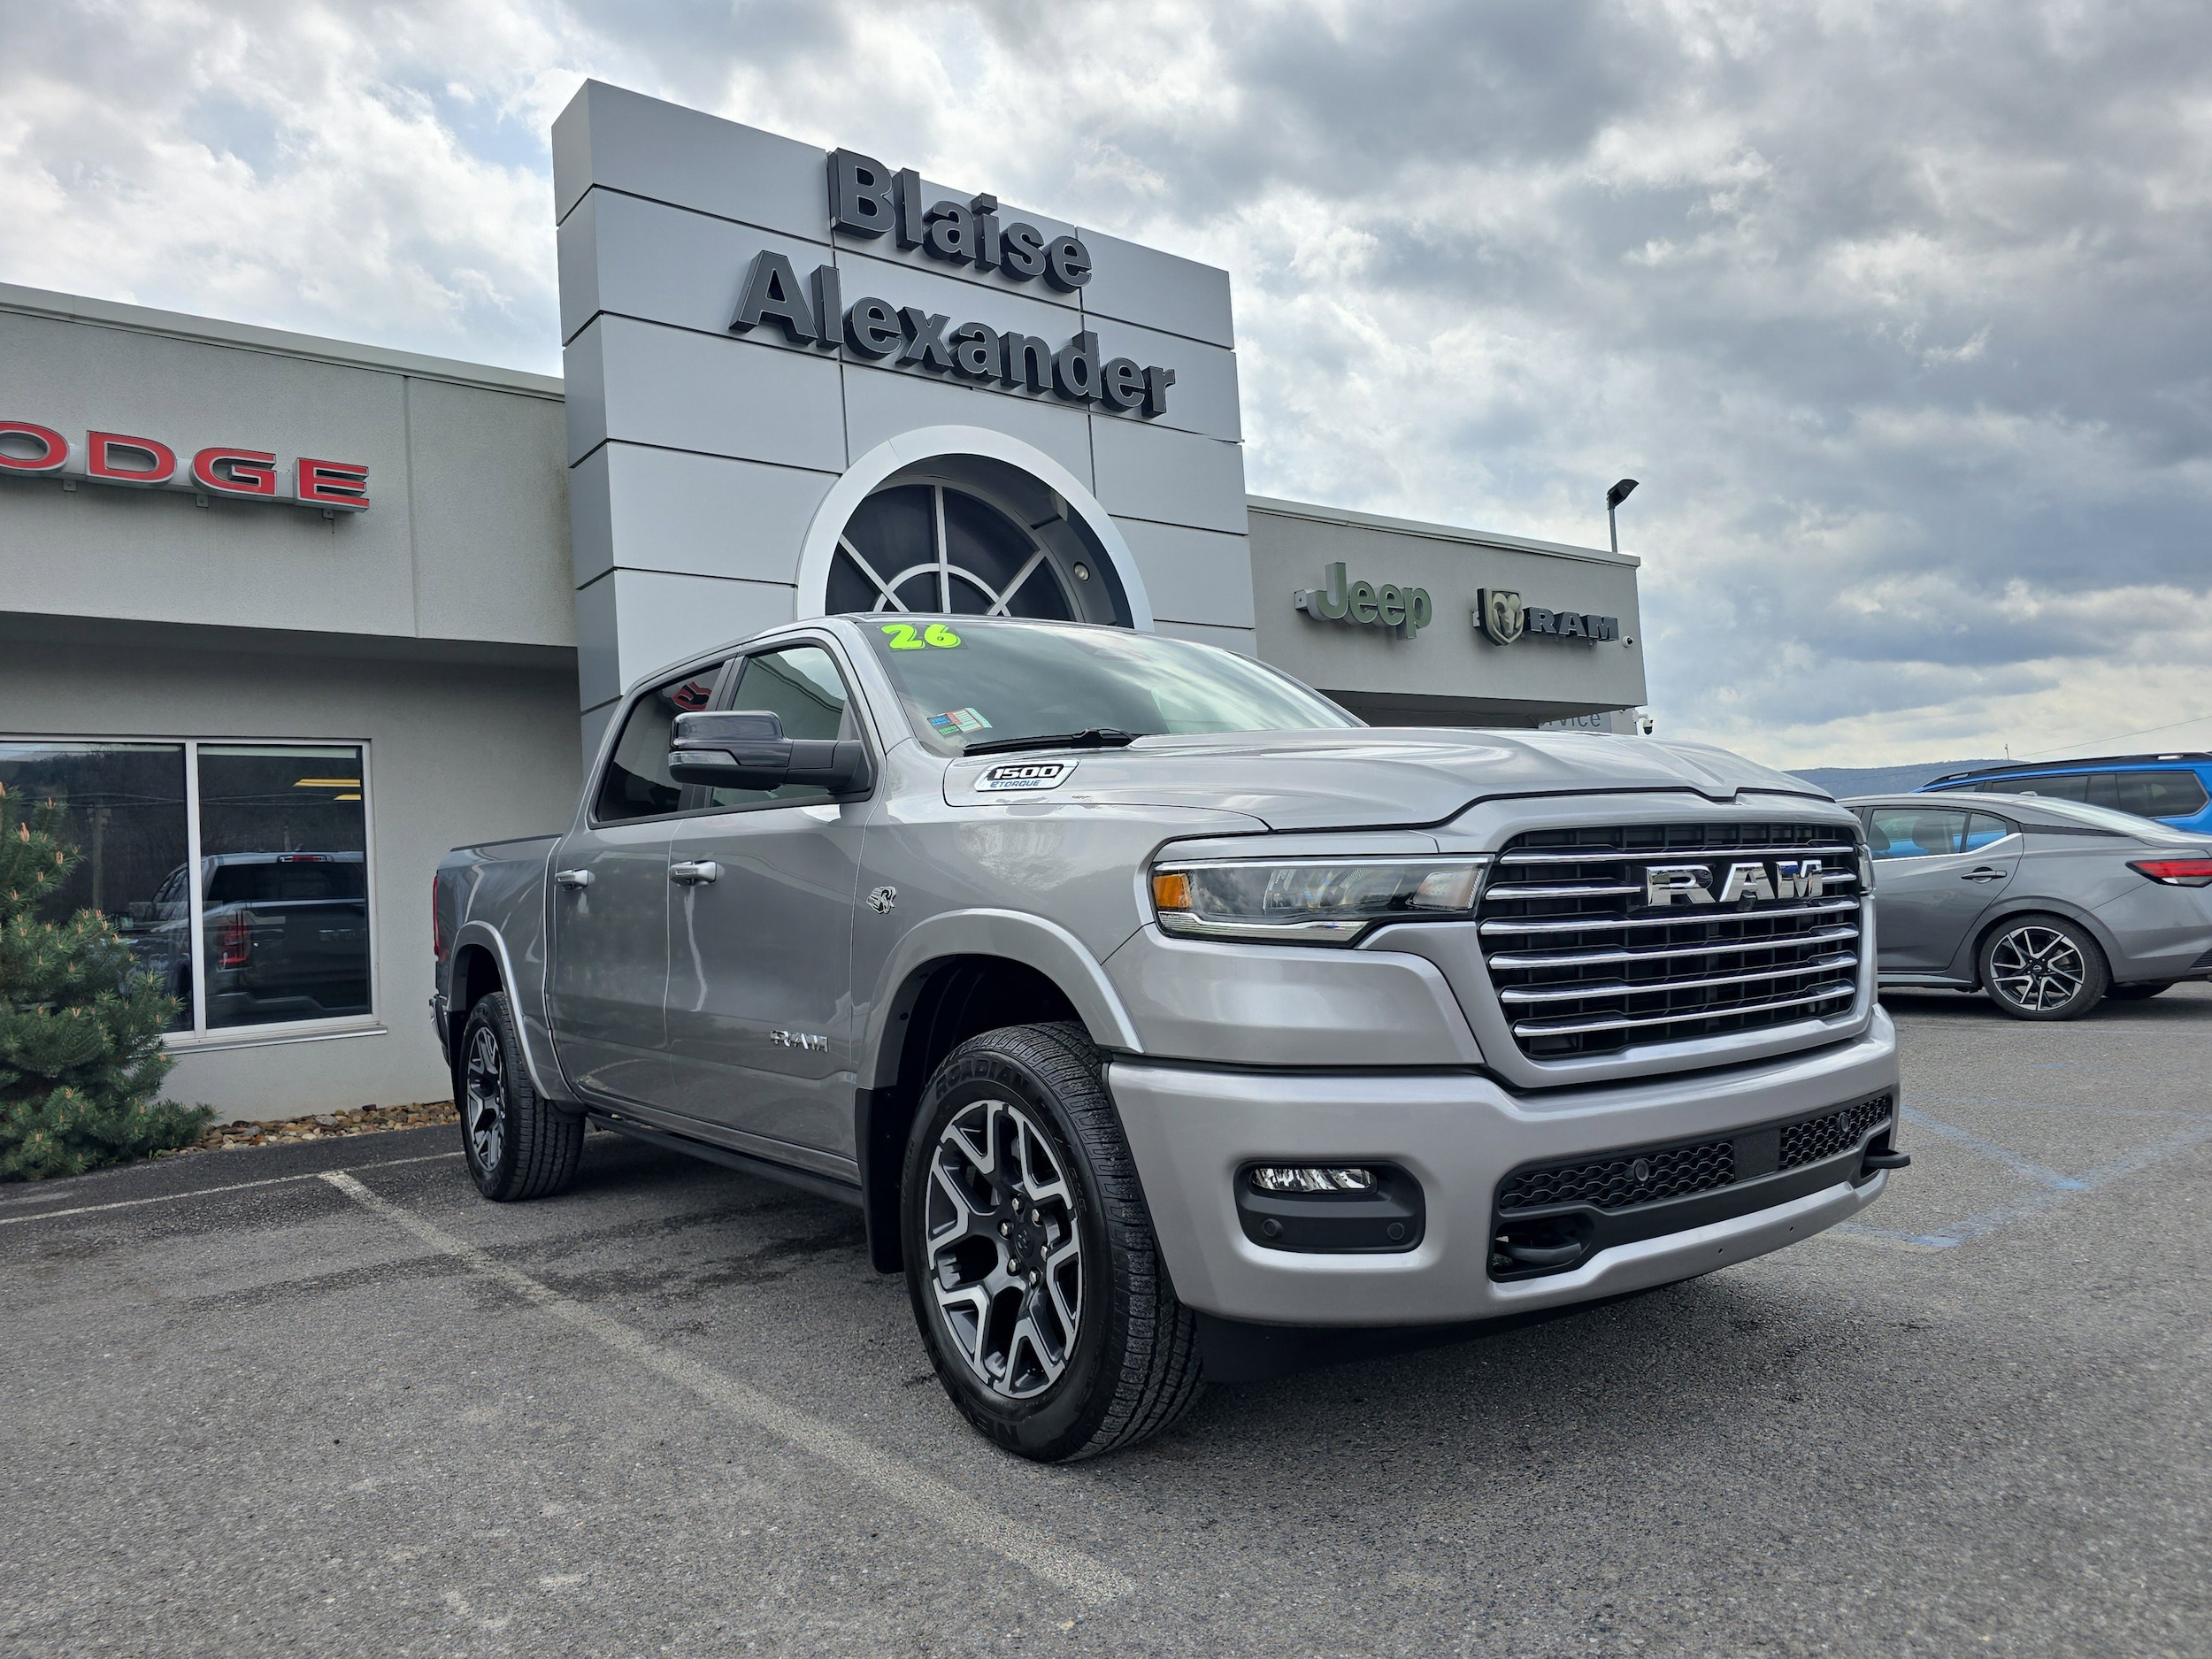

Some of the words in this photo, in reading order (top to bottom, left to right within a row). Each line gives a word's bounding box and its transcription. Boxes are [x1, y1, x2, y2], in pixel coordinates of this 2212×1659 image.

[827, 147, 1093, 294] Blaise
[729, 250, 1175, 418] Alexander
[1308, 562, 1432, 640] Jeep
[881, 624, 961, 649] 26
[1522, 607, 1618, 641] RAM
[994, 766, 1060, 780] 1500
[1647, 859, 1823, 906] RAM
[770, 1029, 830, 1053] RAM
[935, 1058, 1030, 1101] ROADIAN
